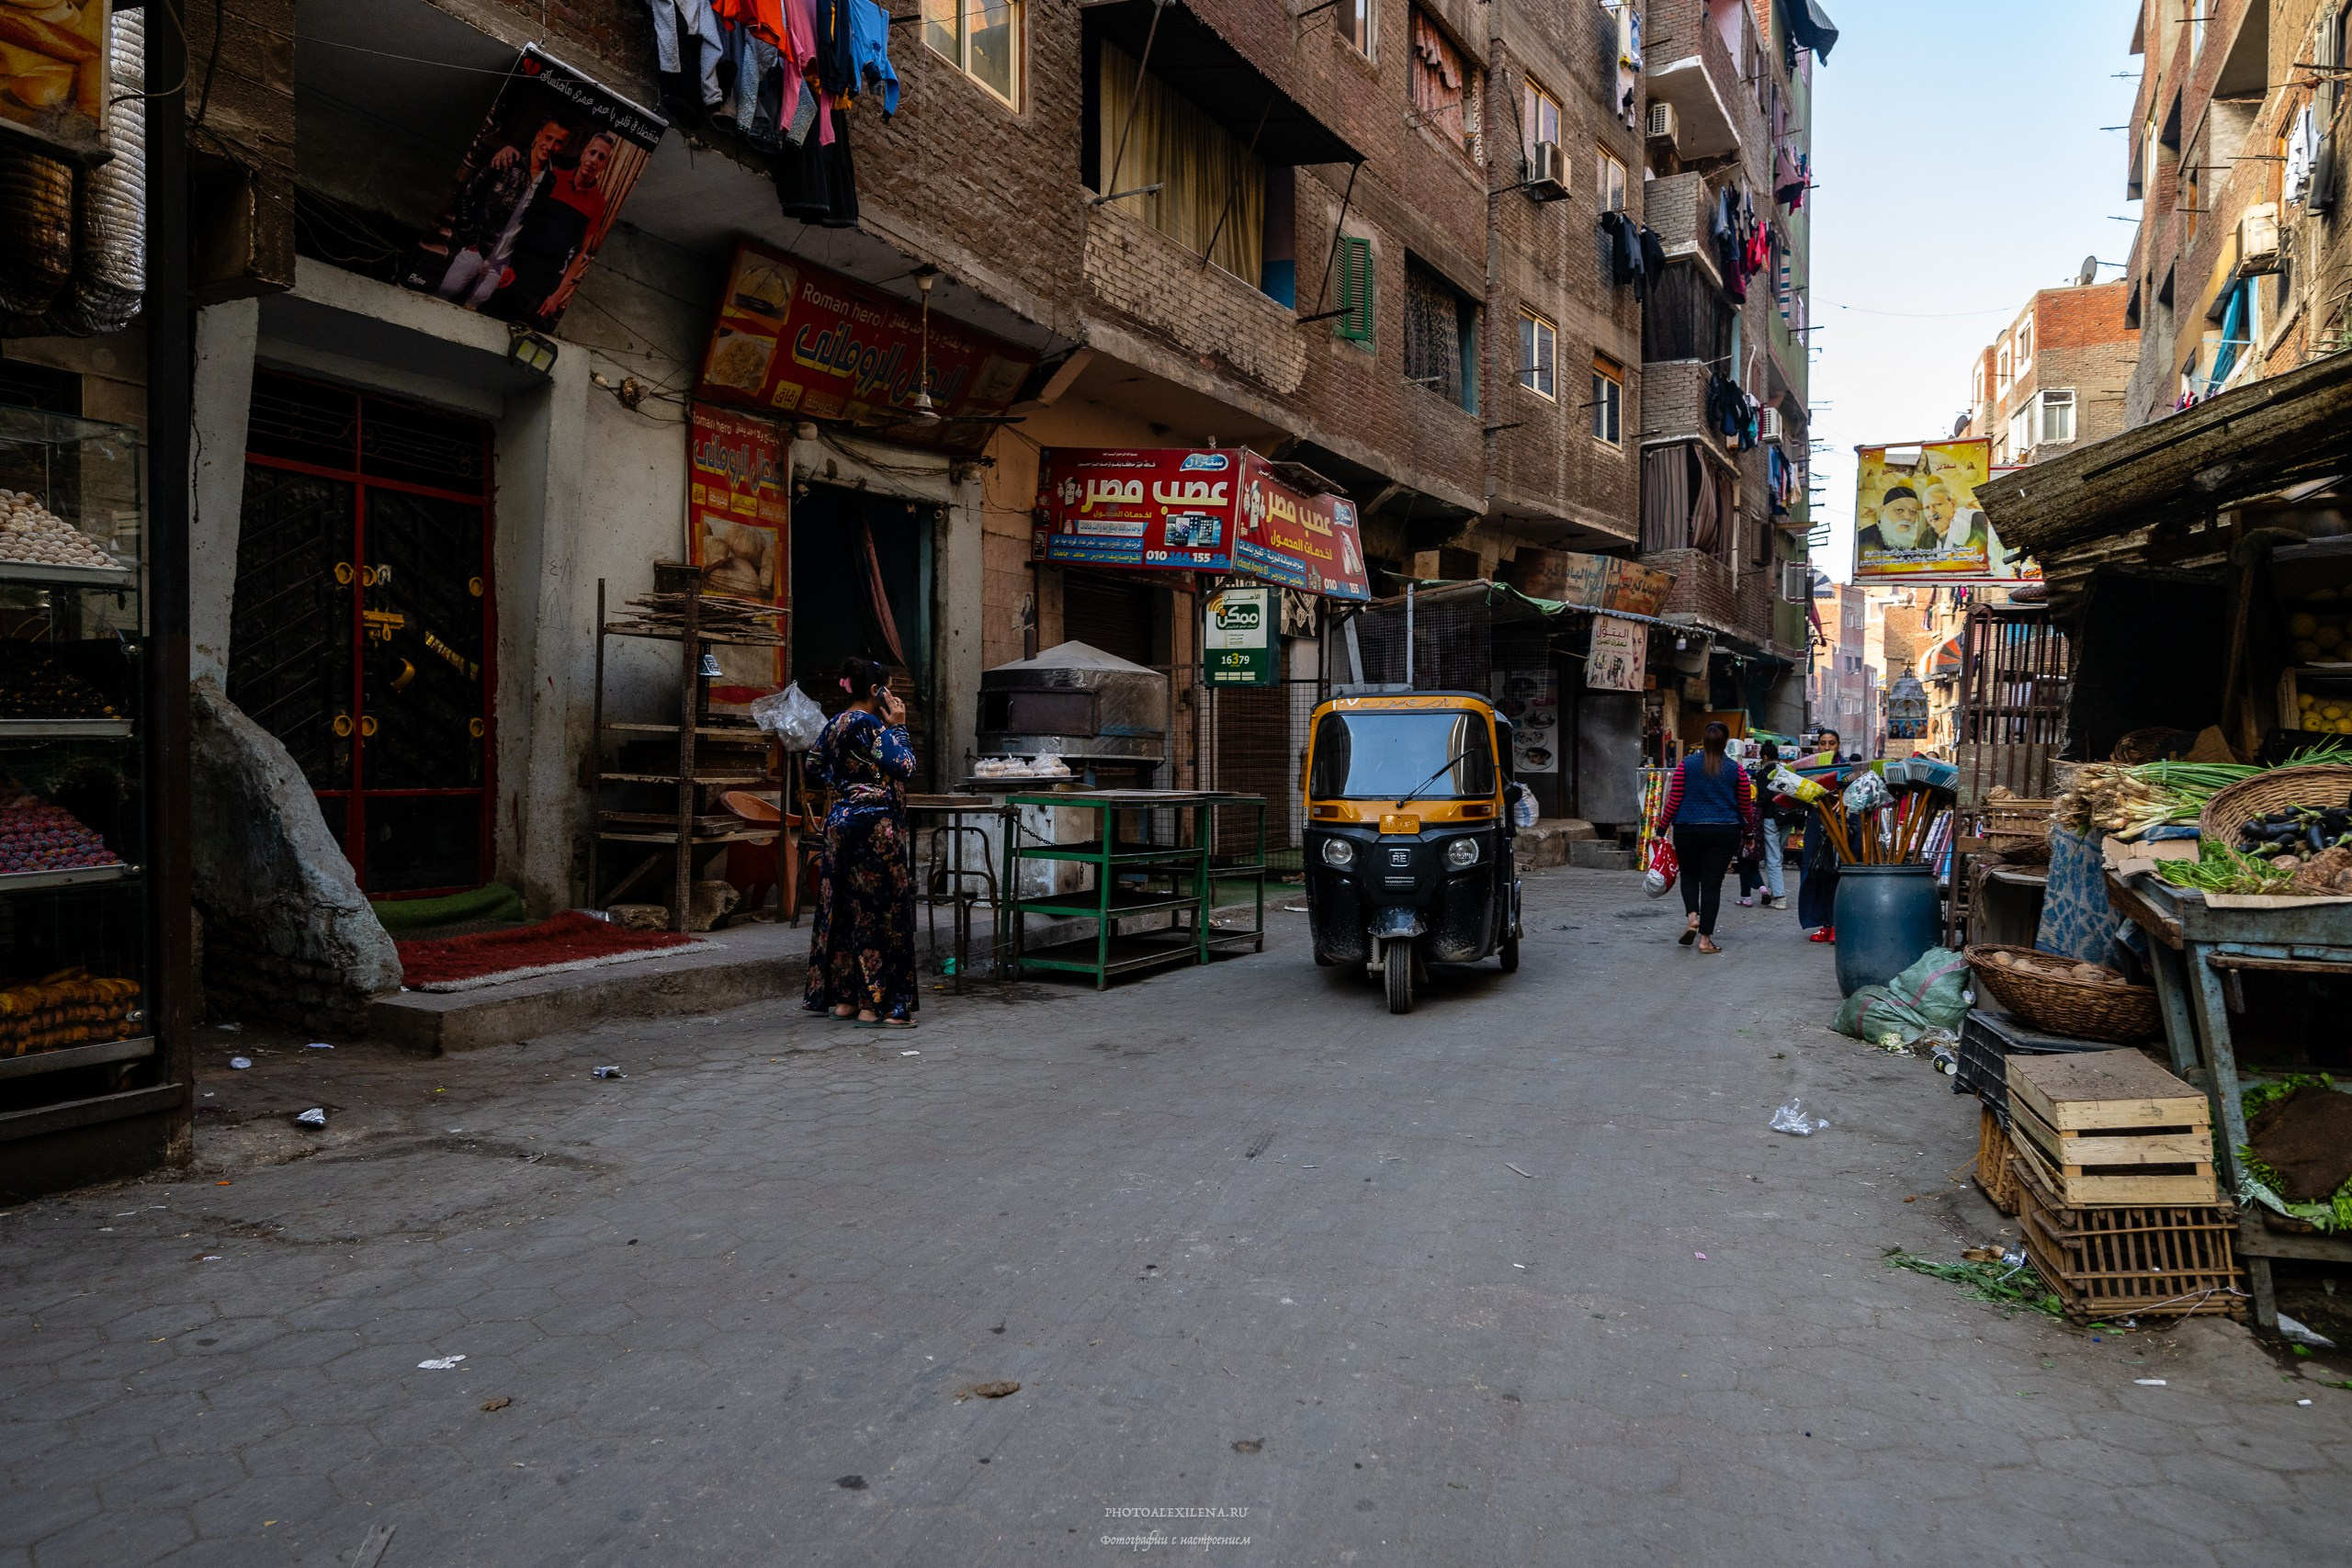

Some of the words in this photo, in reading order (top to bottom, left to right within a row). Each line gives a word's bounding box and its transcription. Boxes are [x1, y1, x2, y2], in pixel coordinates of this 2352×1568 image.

[801, 281, 849, 316] Roman
[853, 300, 882, 327] hero
[716, 419, 732, 435] hero
[1185, 454, 1224, 468] سنترال
[1080, 479, 1144, 513] مصر
[1152, 480, 1228, 514] عصب
[1093, 510, 1124, 519] المحمول
[1266, 491, 1297, 524] مصر
[1299, 506, 1333, 538] عصب
[1270, 529, 1303, 551] المحمول
[1146, 549, 1168, 561] 010
[1193, 552, 1211, 563] 155
[1304, 541, 1333, 561] لخدمات
[1324, 578, 1338, 591] 010
[1349, 582, 1360, 594] 155
[1216, 606, 1259, 628] ممكن
[1221, 652, 1250, 665] 16379
[1392, 854, 1408, 863] RE
